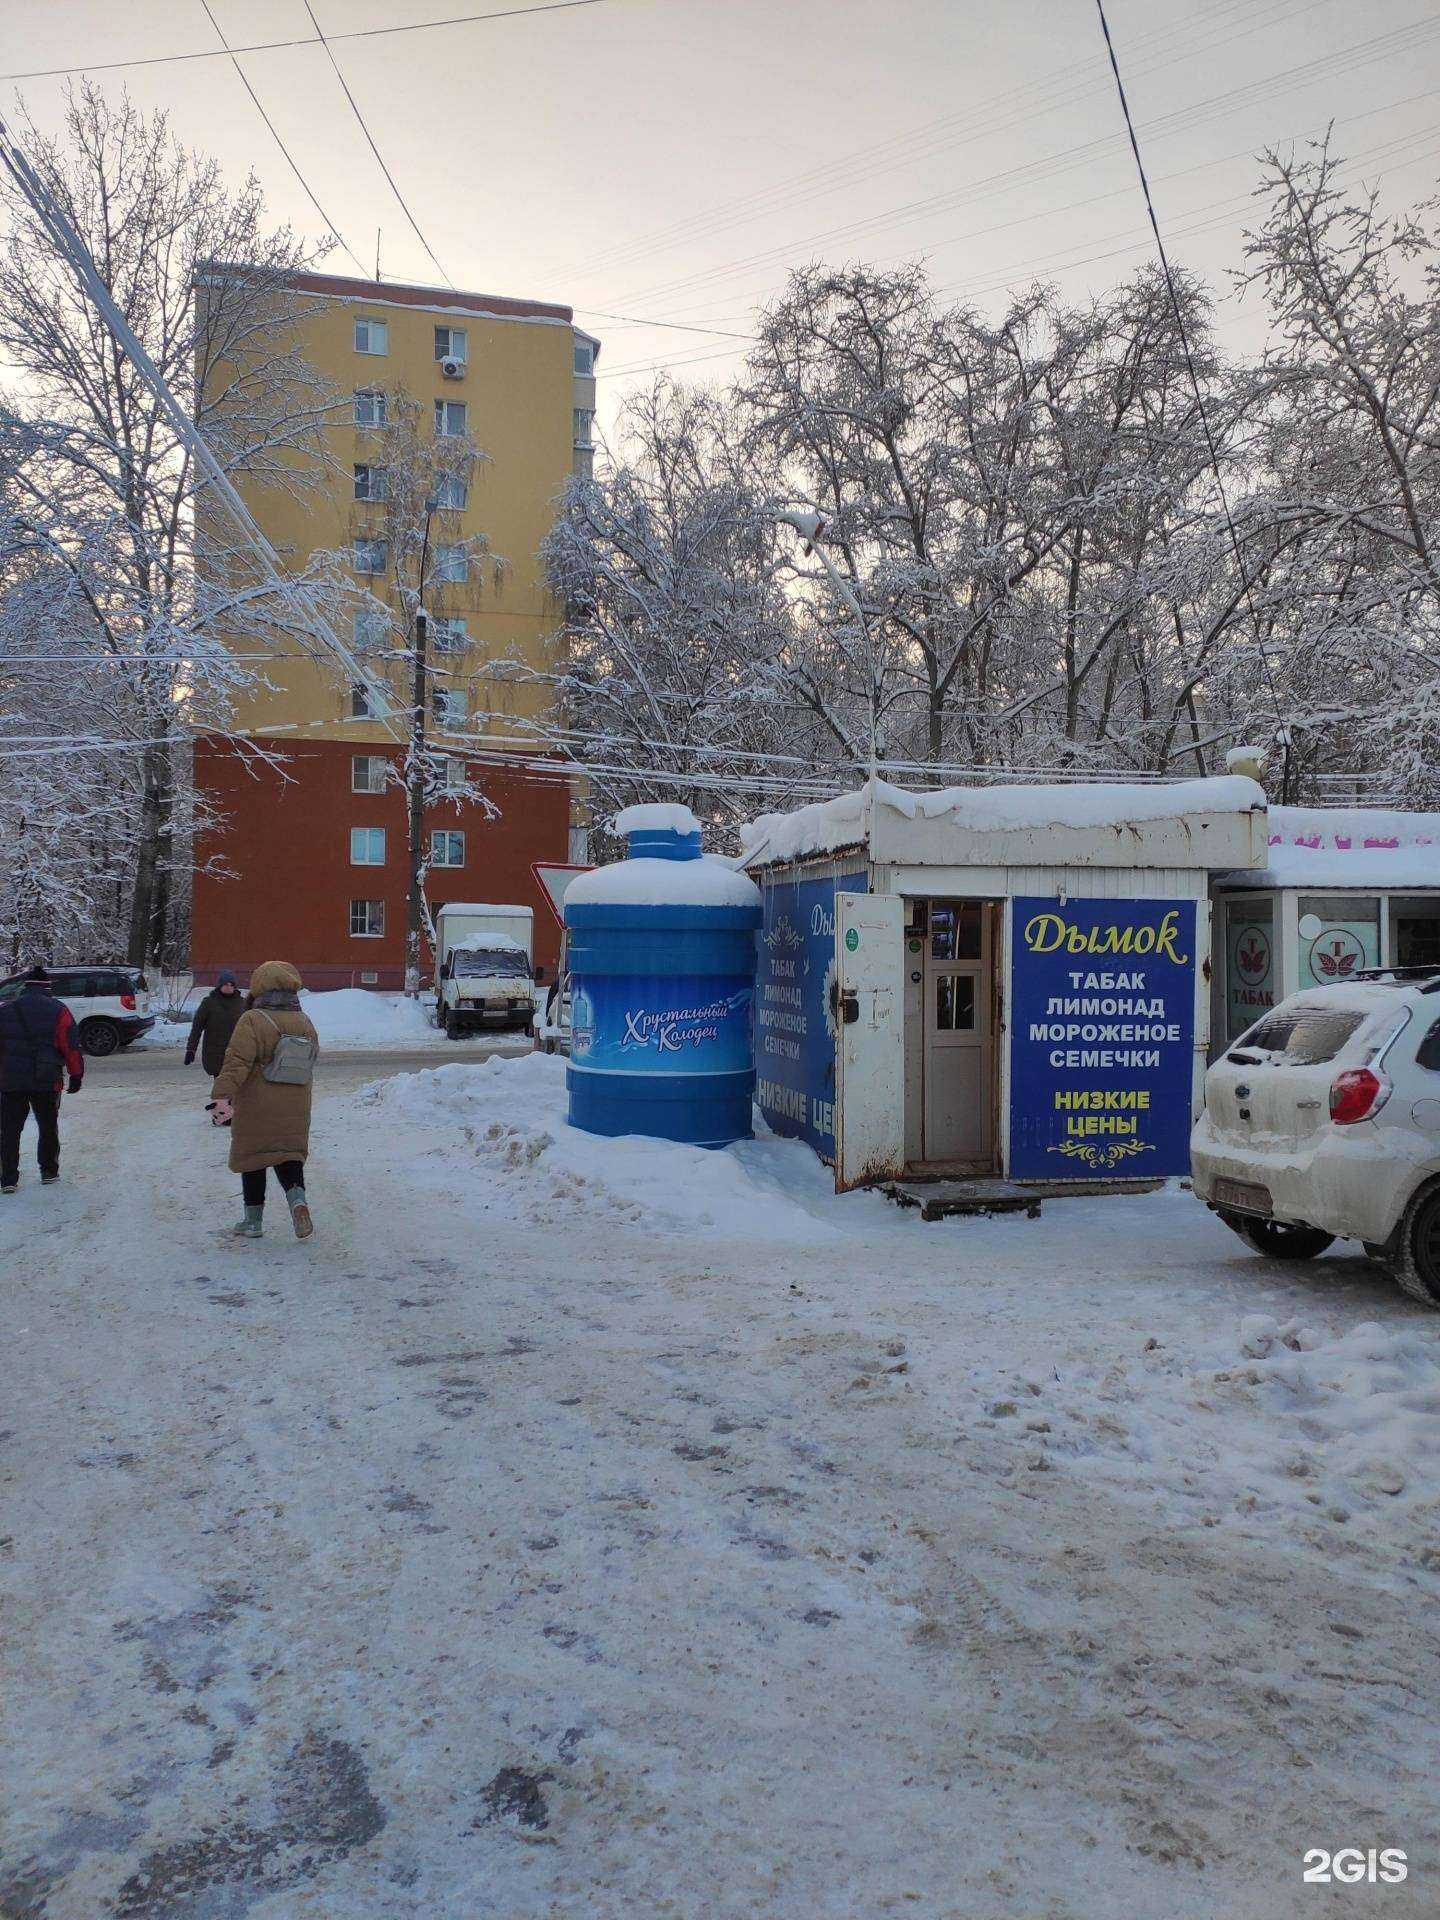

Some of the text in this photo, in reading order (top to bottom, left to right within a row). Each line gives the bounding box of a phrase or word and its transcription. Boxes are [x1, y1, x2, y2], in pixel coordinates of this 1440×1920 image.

[1024, 911, 1189, 965] Дымок
[770, 959, 796, 977] ТАБАК
[1068, 972, 1146, 990] ТАБАК
[1232, 989, 1275, 1006] ТАБАК
[1046, 998, 1165, 1019] ЛИМОНАД
[621, 1005, 729, 1046] Хрустальный
[1029, 1023, 1181, 1041] МОРОЖЕНОЕ
[658, 1022, 718, 1053] Колодец
[1049, 1050, 1160, 1068] СЕМЕЧКИ
[757, 1077, 807, 1124] НИЗКИЕ
[1055, 1091, 1151, 1109] НИЗКИЕ
[1067, 1117, 1137, 1138] ЦЕНЫ
